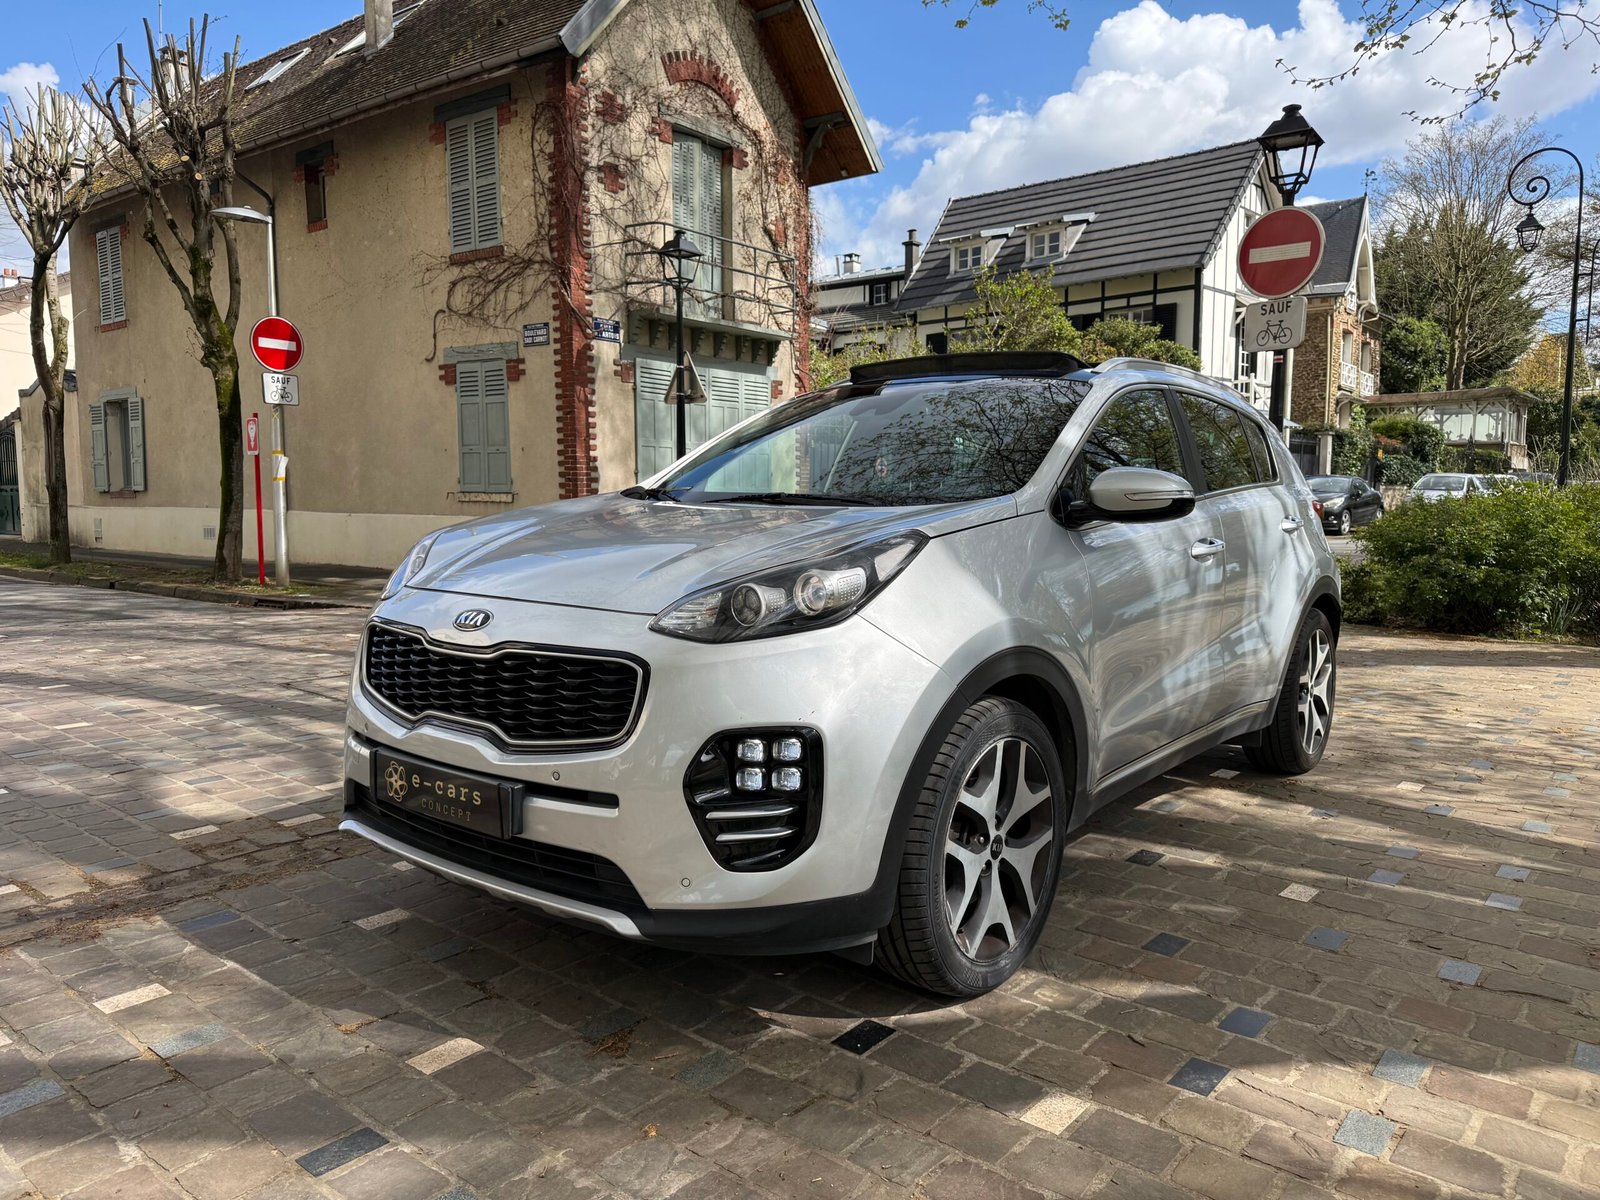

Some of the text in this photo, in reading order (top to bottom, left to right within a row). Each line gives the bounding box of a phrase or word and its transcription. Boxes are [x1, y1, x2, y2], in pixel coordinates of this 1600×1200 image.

[1260, 300, 1292, 316] SAUF
[524, 328, 547, 337] BOULEVARD
[533, 335, 548, 343] CARNOT
[270, 375, 291, 385] SAUF
[456, 611, 485, 626] KIA
[411, 773, 482, 806] e-cars
[421, 798, 472, 822] CONCEPT
